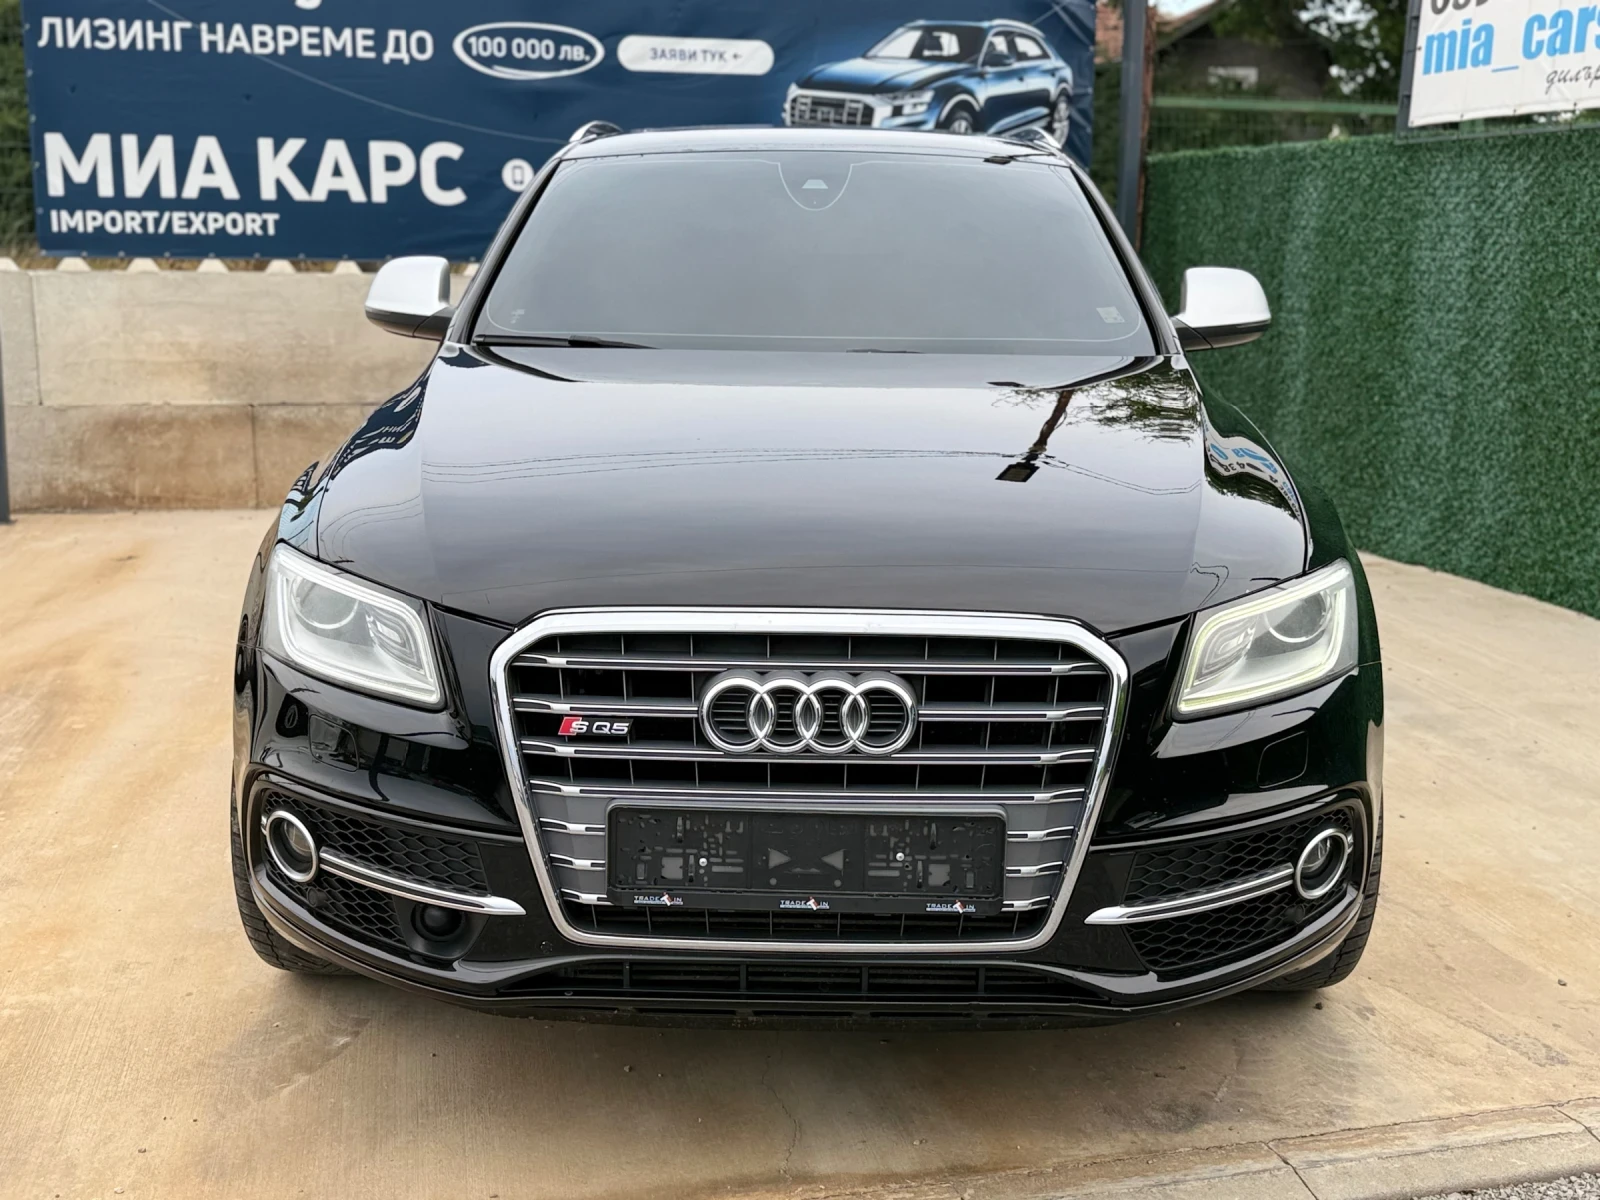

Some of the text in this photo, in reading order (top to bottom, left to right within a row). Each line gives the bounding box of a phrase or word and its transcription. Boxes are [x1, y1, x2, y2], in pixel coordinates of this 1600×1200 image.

[37, 16, 434, 65] ЛИЗИНГ НАВРЕМЕ ДО
[467, 36, 591, 62] 100 000 лв.
[649, 47, 727, 63] ЗАЯВИ ТУК
[43, 132, 467, 206] МИА КАРС
[50, 209, 280, 236] IMPORT/EXPORT
